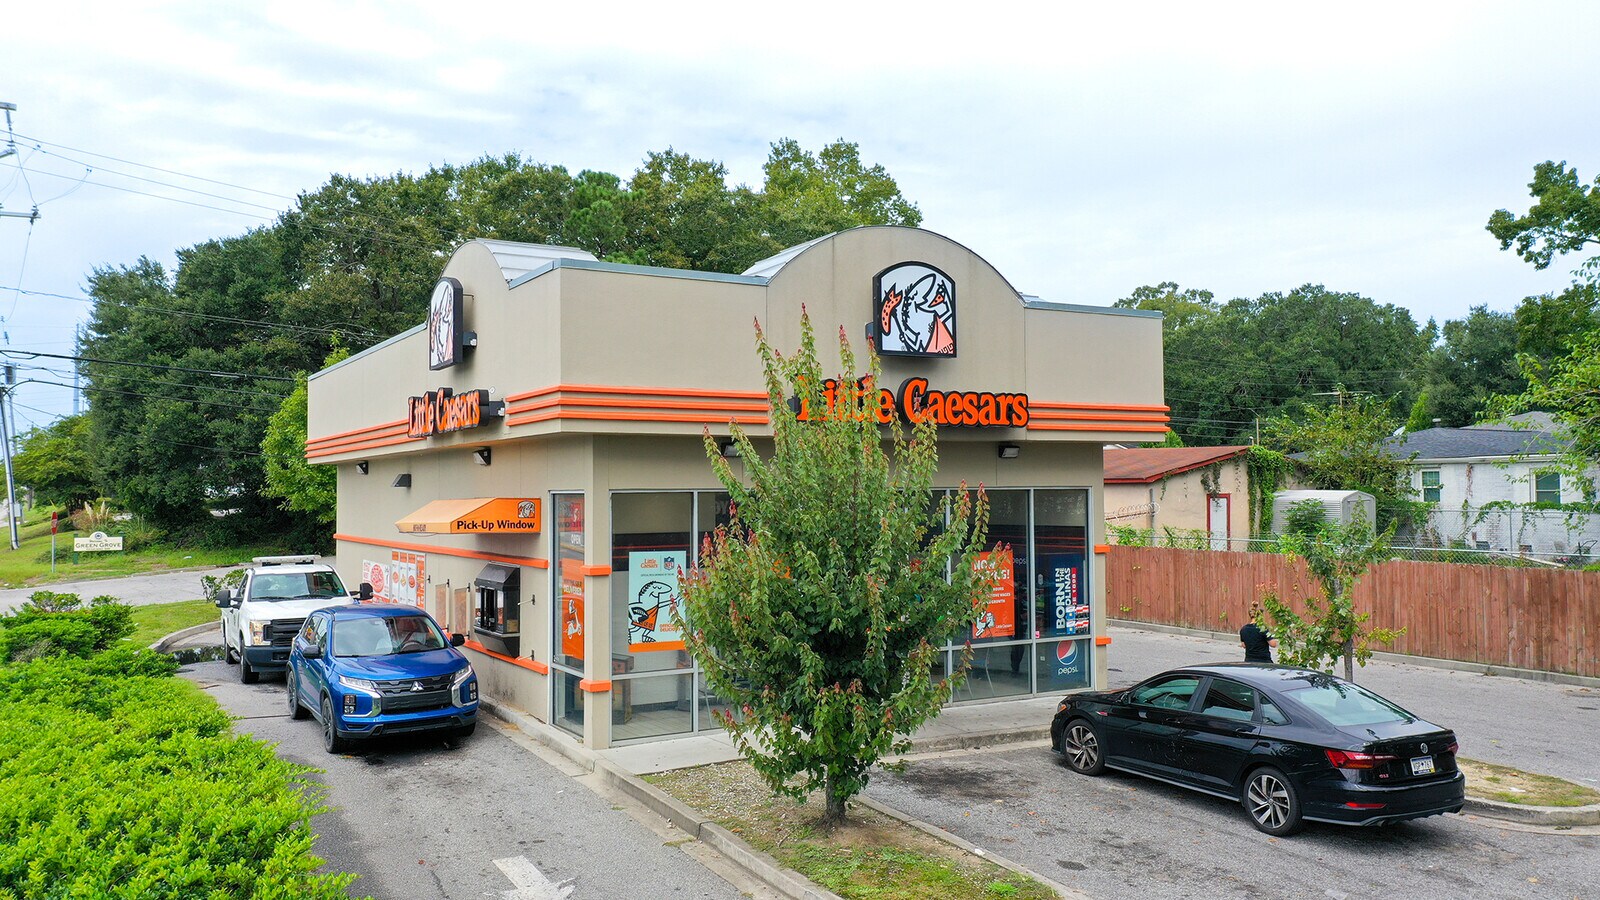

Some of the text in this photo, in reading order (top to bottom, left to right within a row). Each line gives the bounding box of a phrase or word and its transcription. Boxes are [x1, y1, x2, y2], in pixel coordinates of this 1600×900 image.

[904, 378, 1028, 426] Caesars
[408, 388, 481, 437] Little Caesars
[456, 519, 536, 531] Pick-Up Window
[570, 533, 582, 545] OPEN
[562, 585, 582, 596] DELIVERED
[1055, 583, 1066, 629] BORN
[1058, 666, 1079, 675] pepsi
